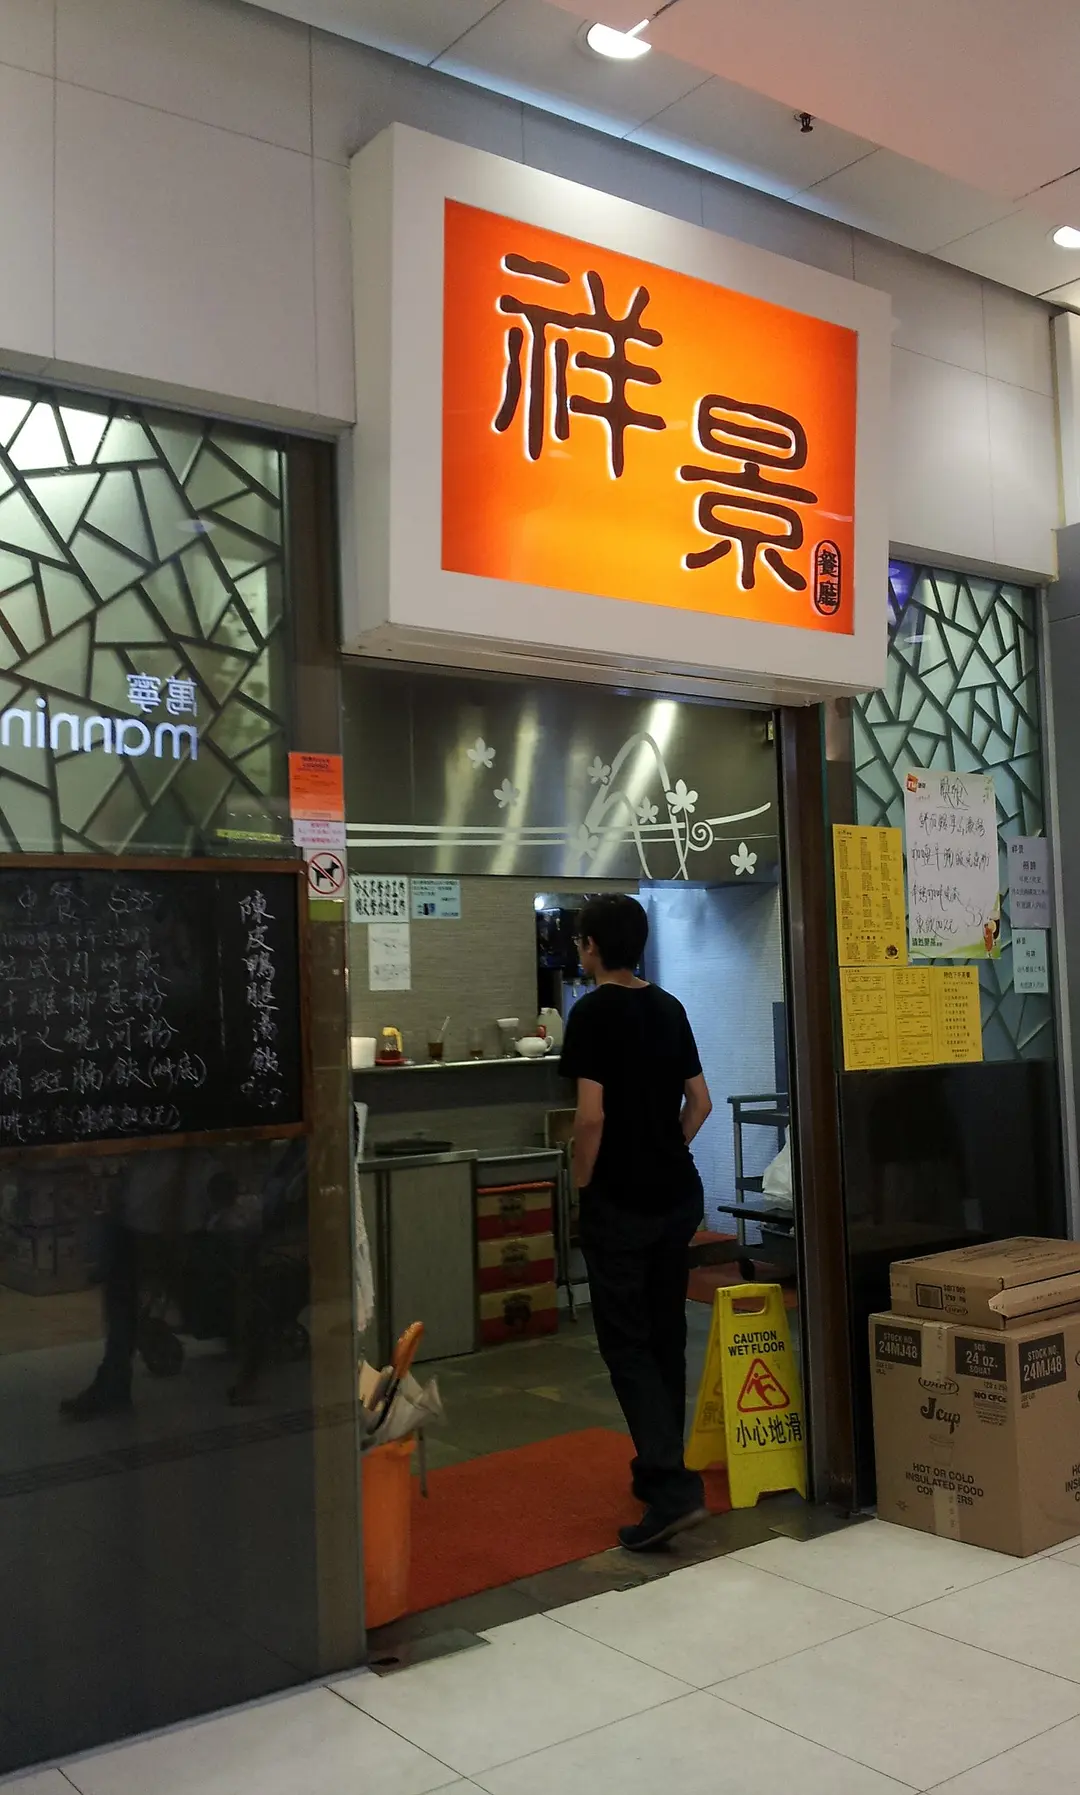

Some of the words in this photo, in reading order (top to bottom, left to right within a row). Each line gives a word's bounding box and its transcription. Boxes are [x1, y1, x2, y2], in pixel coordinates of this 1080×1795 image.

[492, 253, 818, 591] 祥景
[733, 1330, 777, 1344] CAUTION
[883, 1331, 902, 1343] STOCK
[728, 1344, 751, 1357] WET
[751, 1341, 785, 1355] FLOOR
[878, 1340, 918, 1359] 24MJ48
[1027, 1348, 1047, 1362] STOCK
[966, 1351, 979, 1365] 24
[982, 1355, 998, 1369] OZ.
[1023, 1355, 1062, 1382] 24MJ48
[736, 1413, 802, 1448] 小心地滑
[912, 1463, 931, 1475] HOT
[933, 1467, 946, 1478] OR
[948, 1471, 975, 1484] COLD
[905, 1471, 955, 1491] INSULATED
[957, 1484, 984, 1497] FOOD
